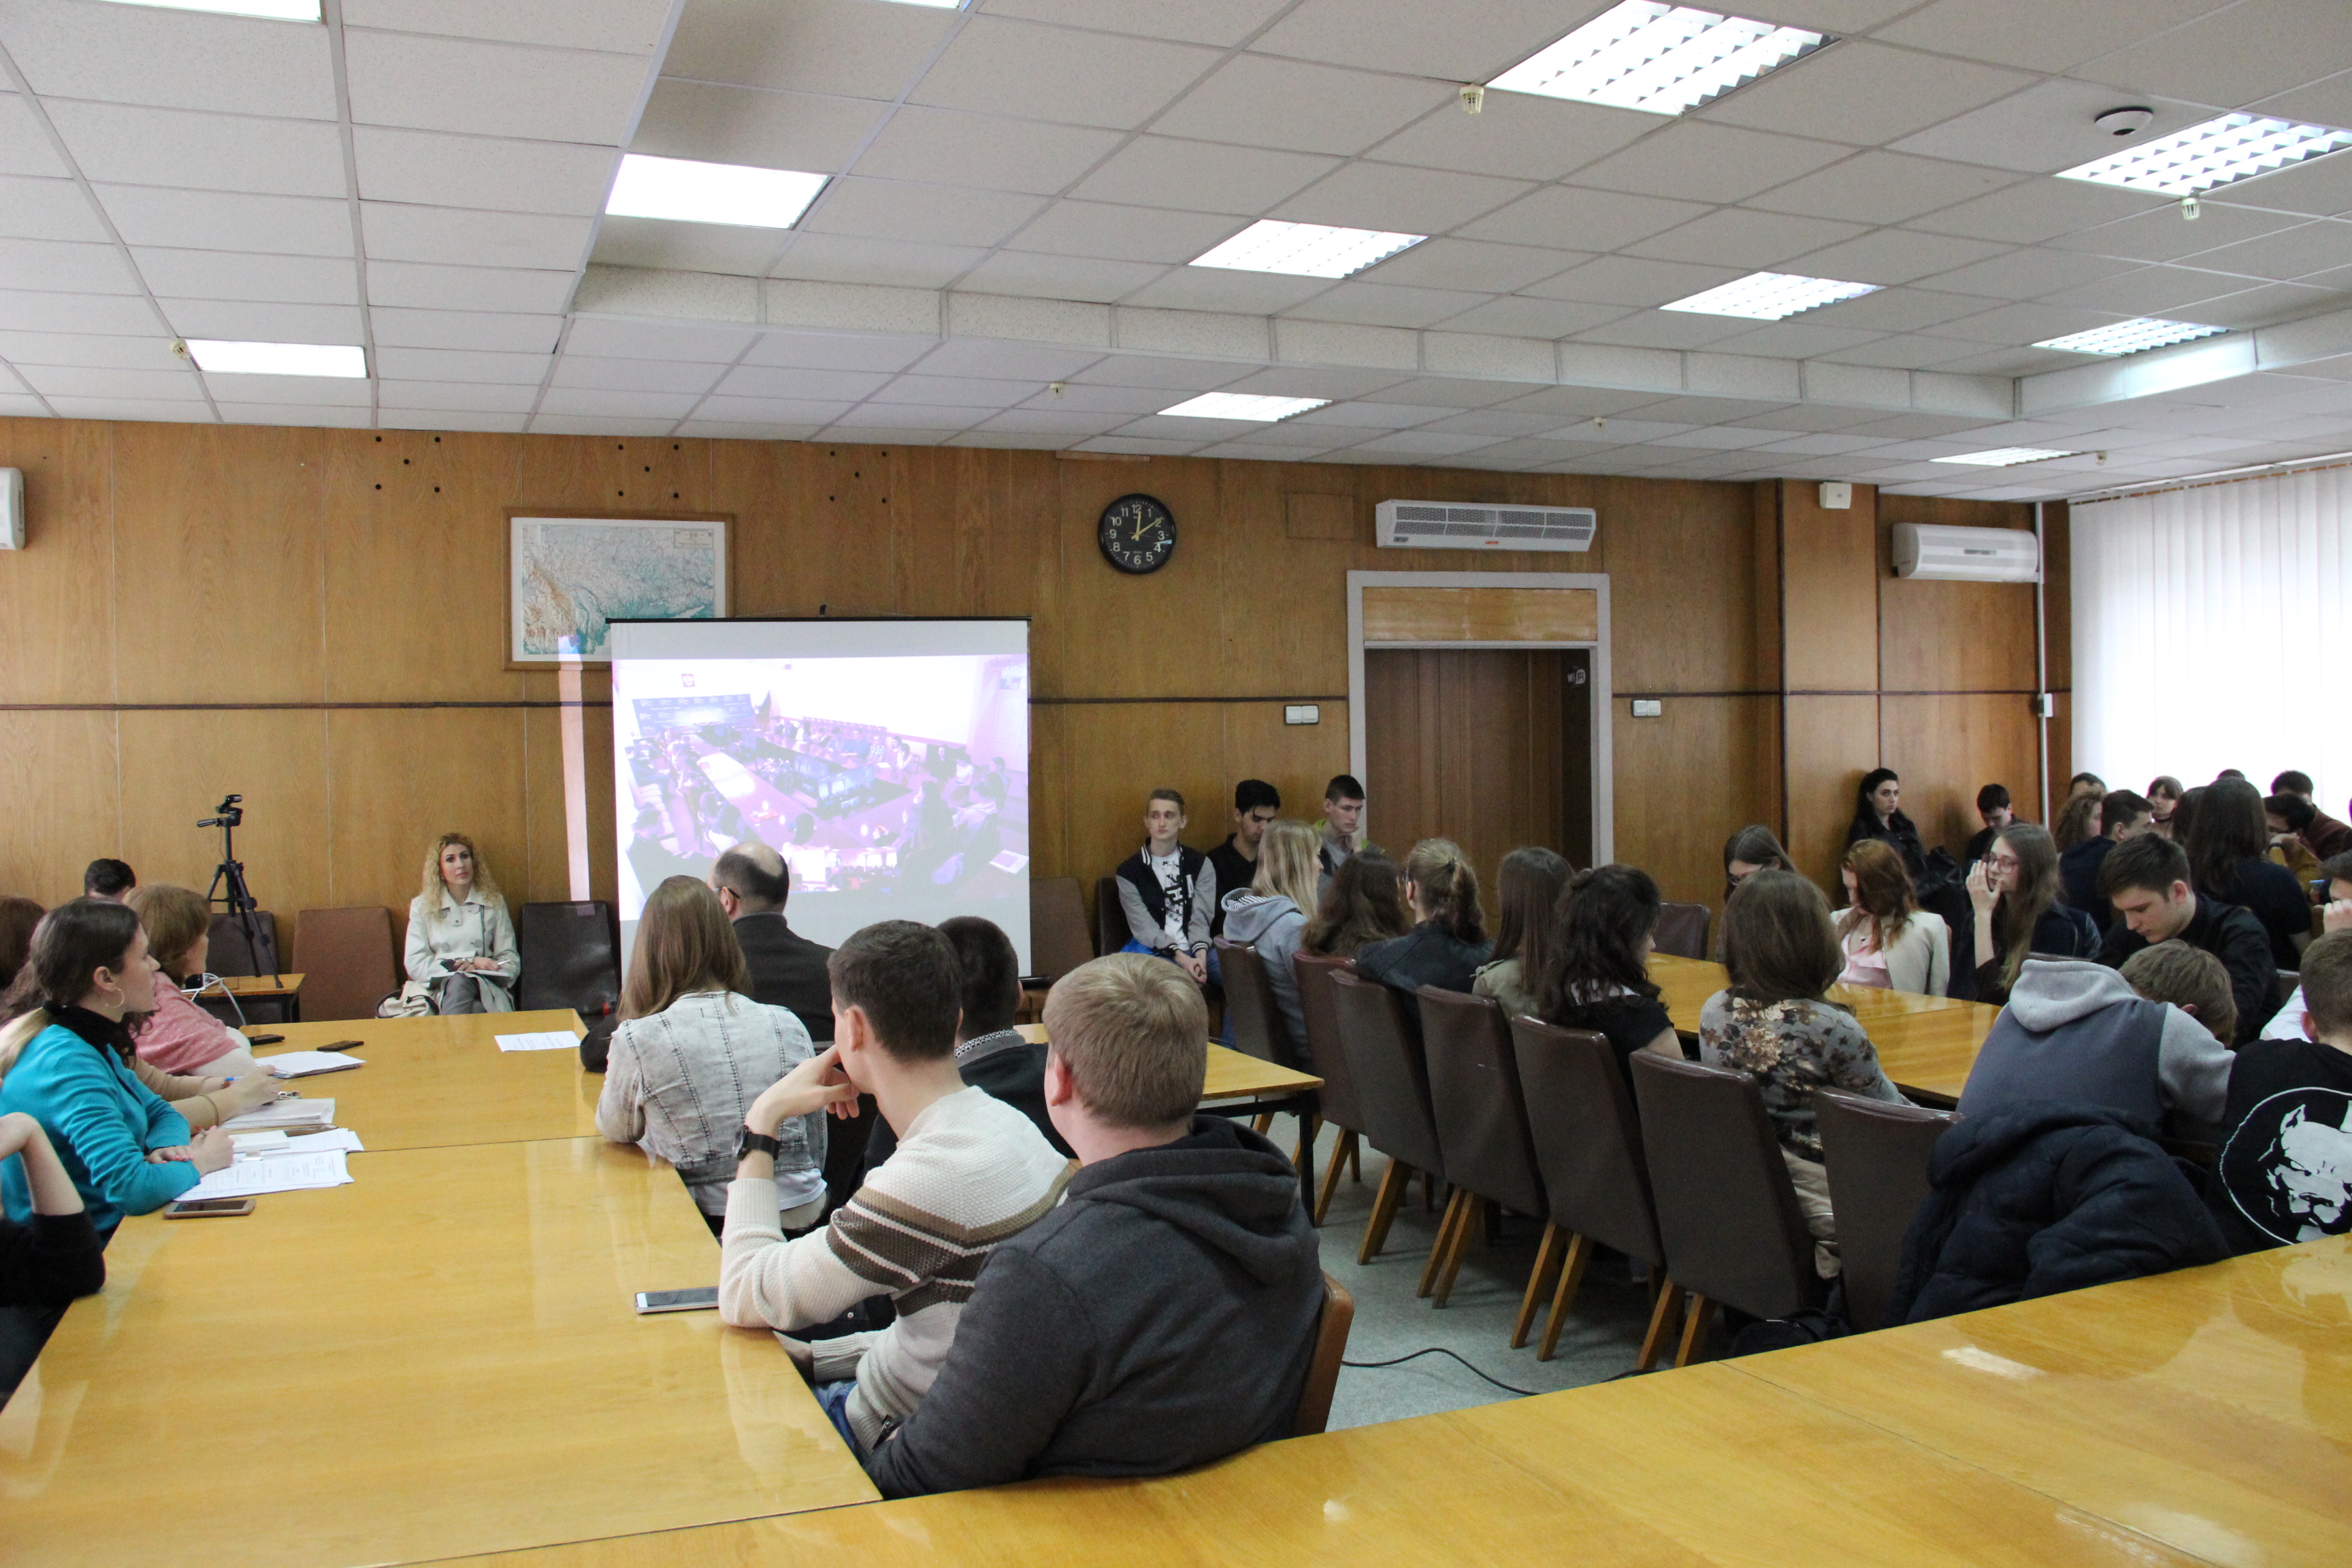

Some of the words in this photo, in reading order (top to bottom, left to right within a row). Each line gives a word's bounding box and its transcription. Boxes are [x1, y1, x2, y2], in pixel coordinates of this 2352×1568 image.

[1121, 508, 1128, 517] 11
[1147, 508, 1152, 517] 1
[1111, 517, 1122, 527] 10
[1109, 529, 1117, 539] 9
[1158, 531, 1165, 540] 3
[1113, 542, 1121, 552] 8
[1154, 542, 1162, 553] 4
[1123, 551, 1130, 561] 7
[1133, 555, 1141, 565] 6
[1145, 551, 1154, 561] 5
